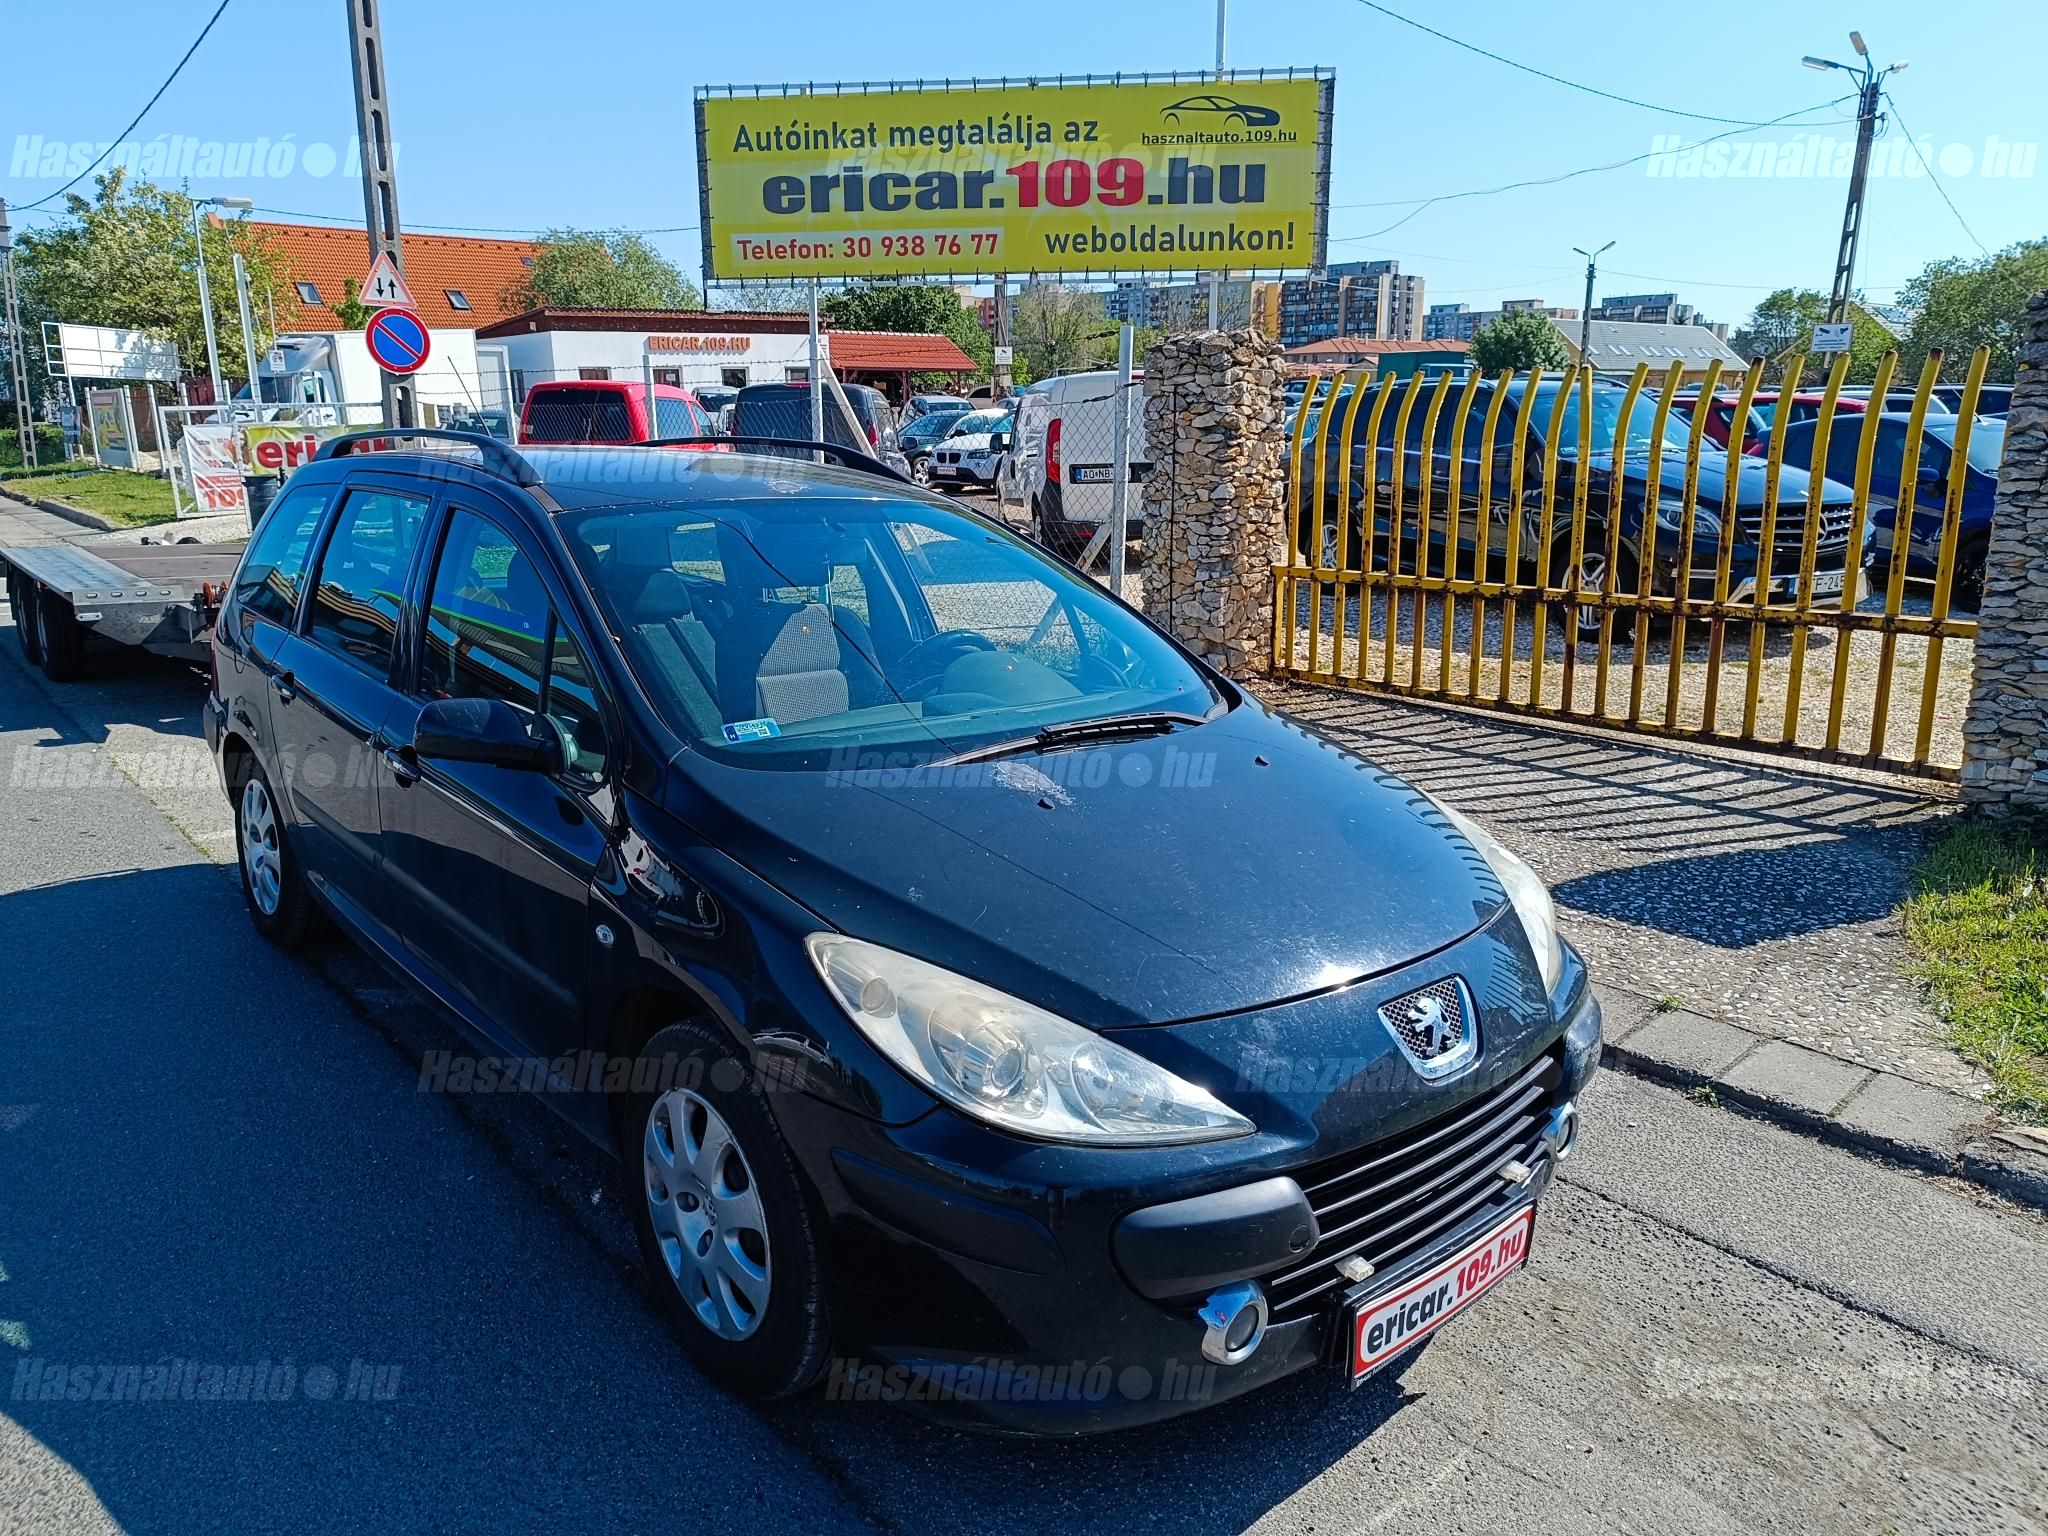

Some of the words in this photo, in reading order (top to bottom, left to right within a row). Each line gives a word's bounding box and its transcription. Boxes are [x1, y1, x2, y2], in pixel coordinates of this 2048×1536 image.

[733, 120, 877, 153] Autóinkat
[889, 111, 1052, 153] megtalálja
[1064, 120, 1099, 142] az
[1142, 130, 1297, 145] hasznaltauto.109.hu
[763, 157, 1266, 214] ericar.109.hu
[737, 238, 835, 260] Telefon:
[842, 236, 872, 258] 30
[880, 235, 925, 257] 938
[934, 234, 962, 256] 76
[970, 233, 998, 255] 77
[1045, 222, 1295, 254] weboldalunkon!
[649, 336, 750, 351] ERICAR.109.HU
[1367, 1230, 1523, 1354] ericar.109.hu
